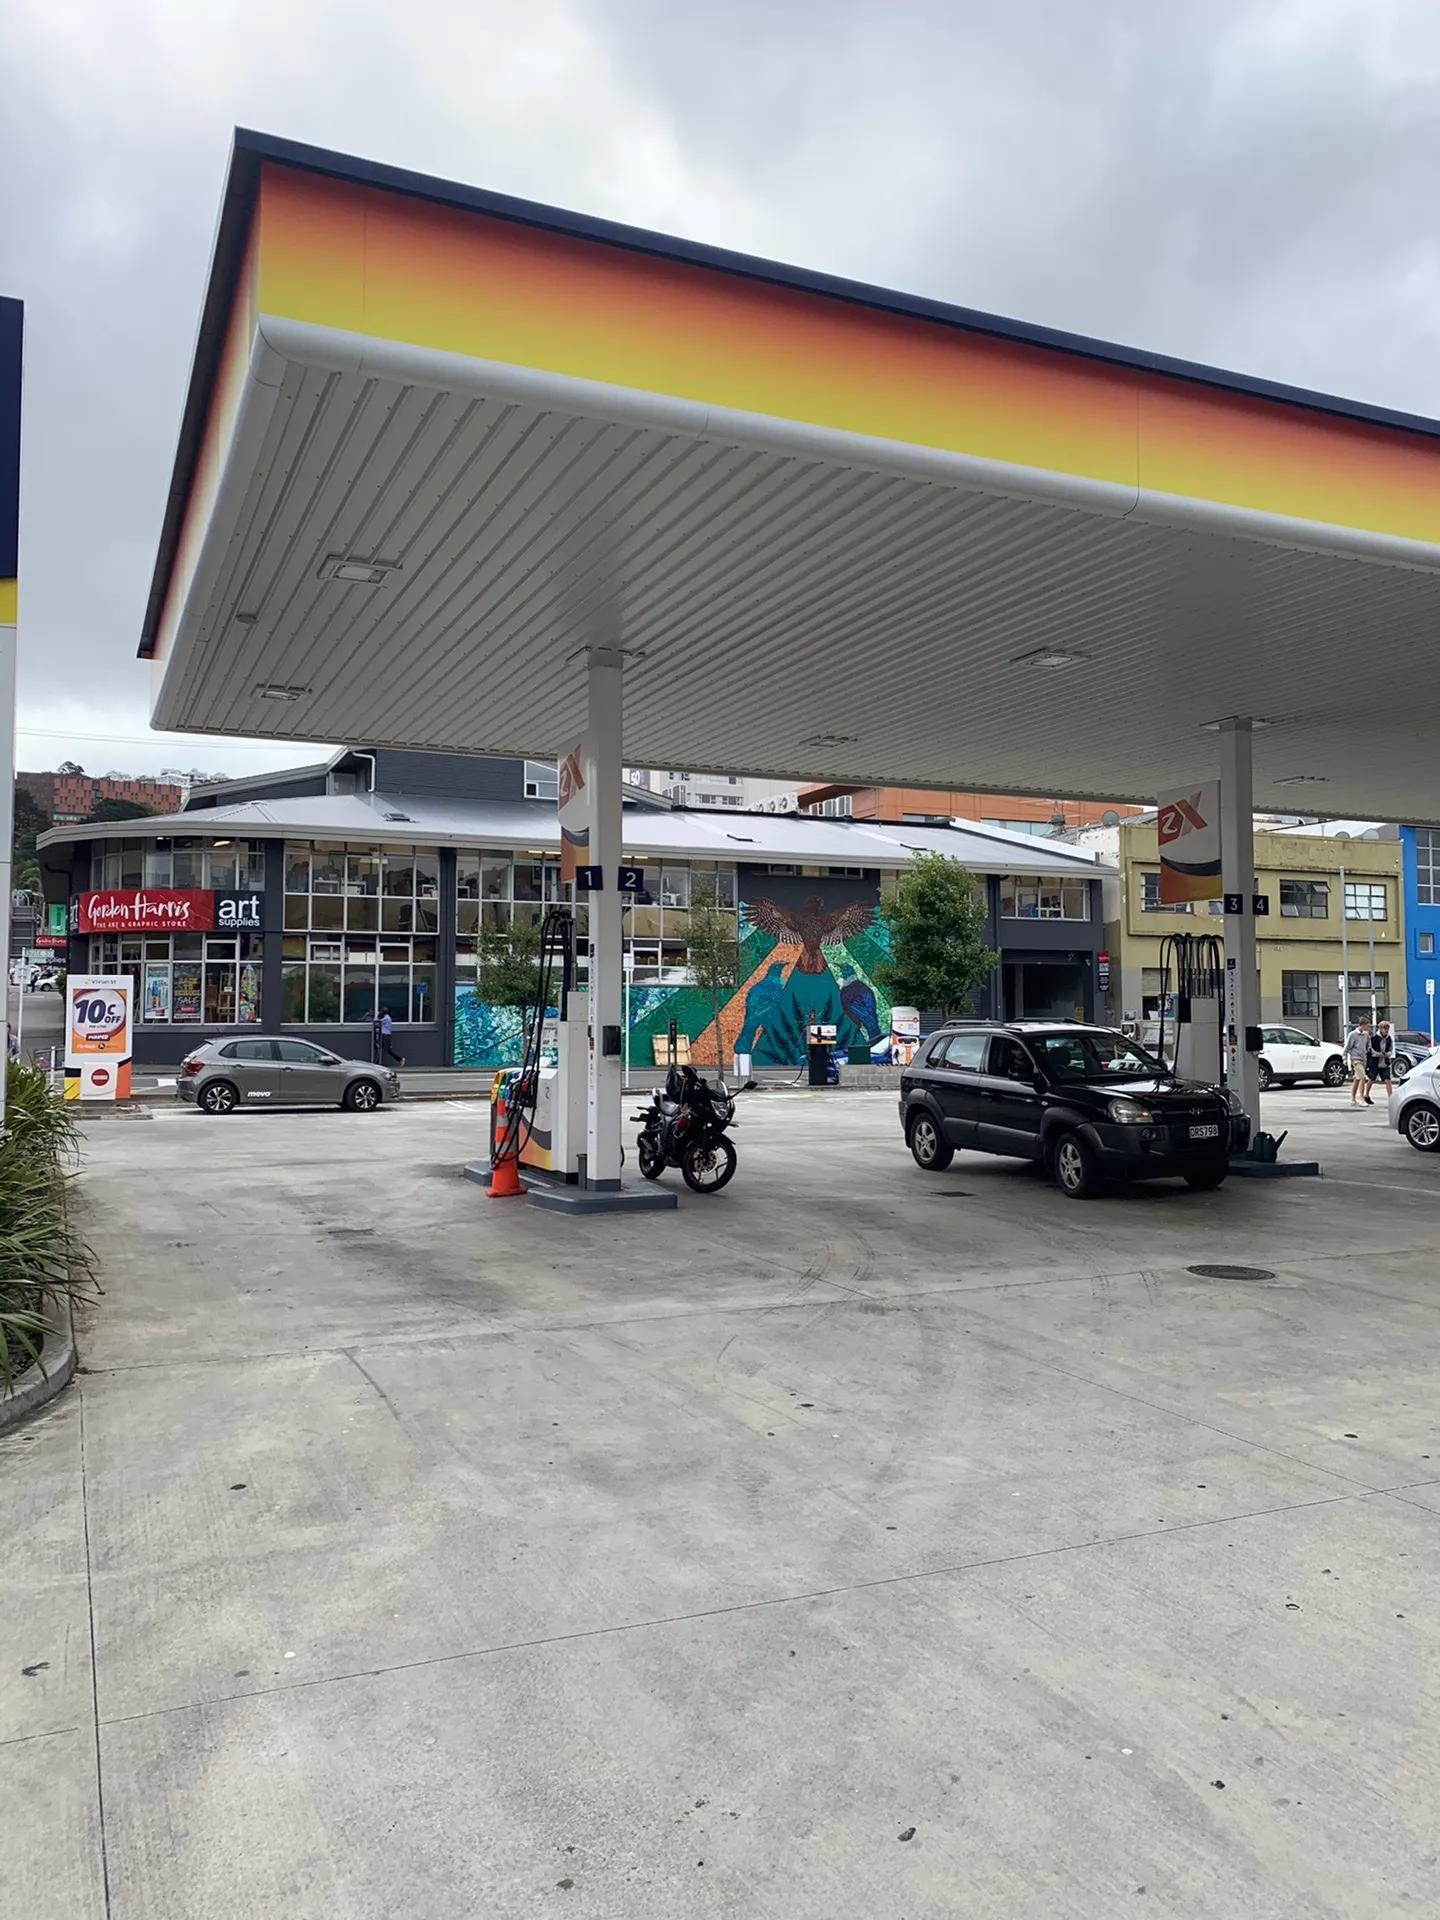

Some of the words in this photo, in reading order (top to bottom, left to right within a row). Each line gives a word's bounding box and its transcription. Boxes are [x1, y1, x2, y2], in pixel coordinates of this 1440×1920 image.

[584, 871, 593, 887] 1
[625, 871, 637, 888] 2
[88, 894, 129, 927] Gordon
[129, 892, 190, 921] Harris
[218, 895, 260, 919] art
[1230, 897, 1238, 911] 3
[1256, 897, 1265, 912] 4
[128, 920, 159, 928] GRAPHIC
[162, 920, 187, 928] STORE
[218, 917, 260, 928] supplies
[104, 1015, 122, 1024] OFF
[1190, 1126, 1217, 1138] DRS798
